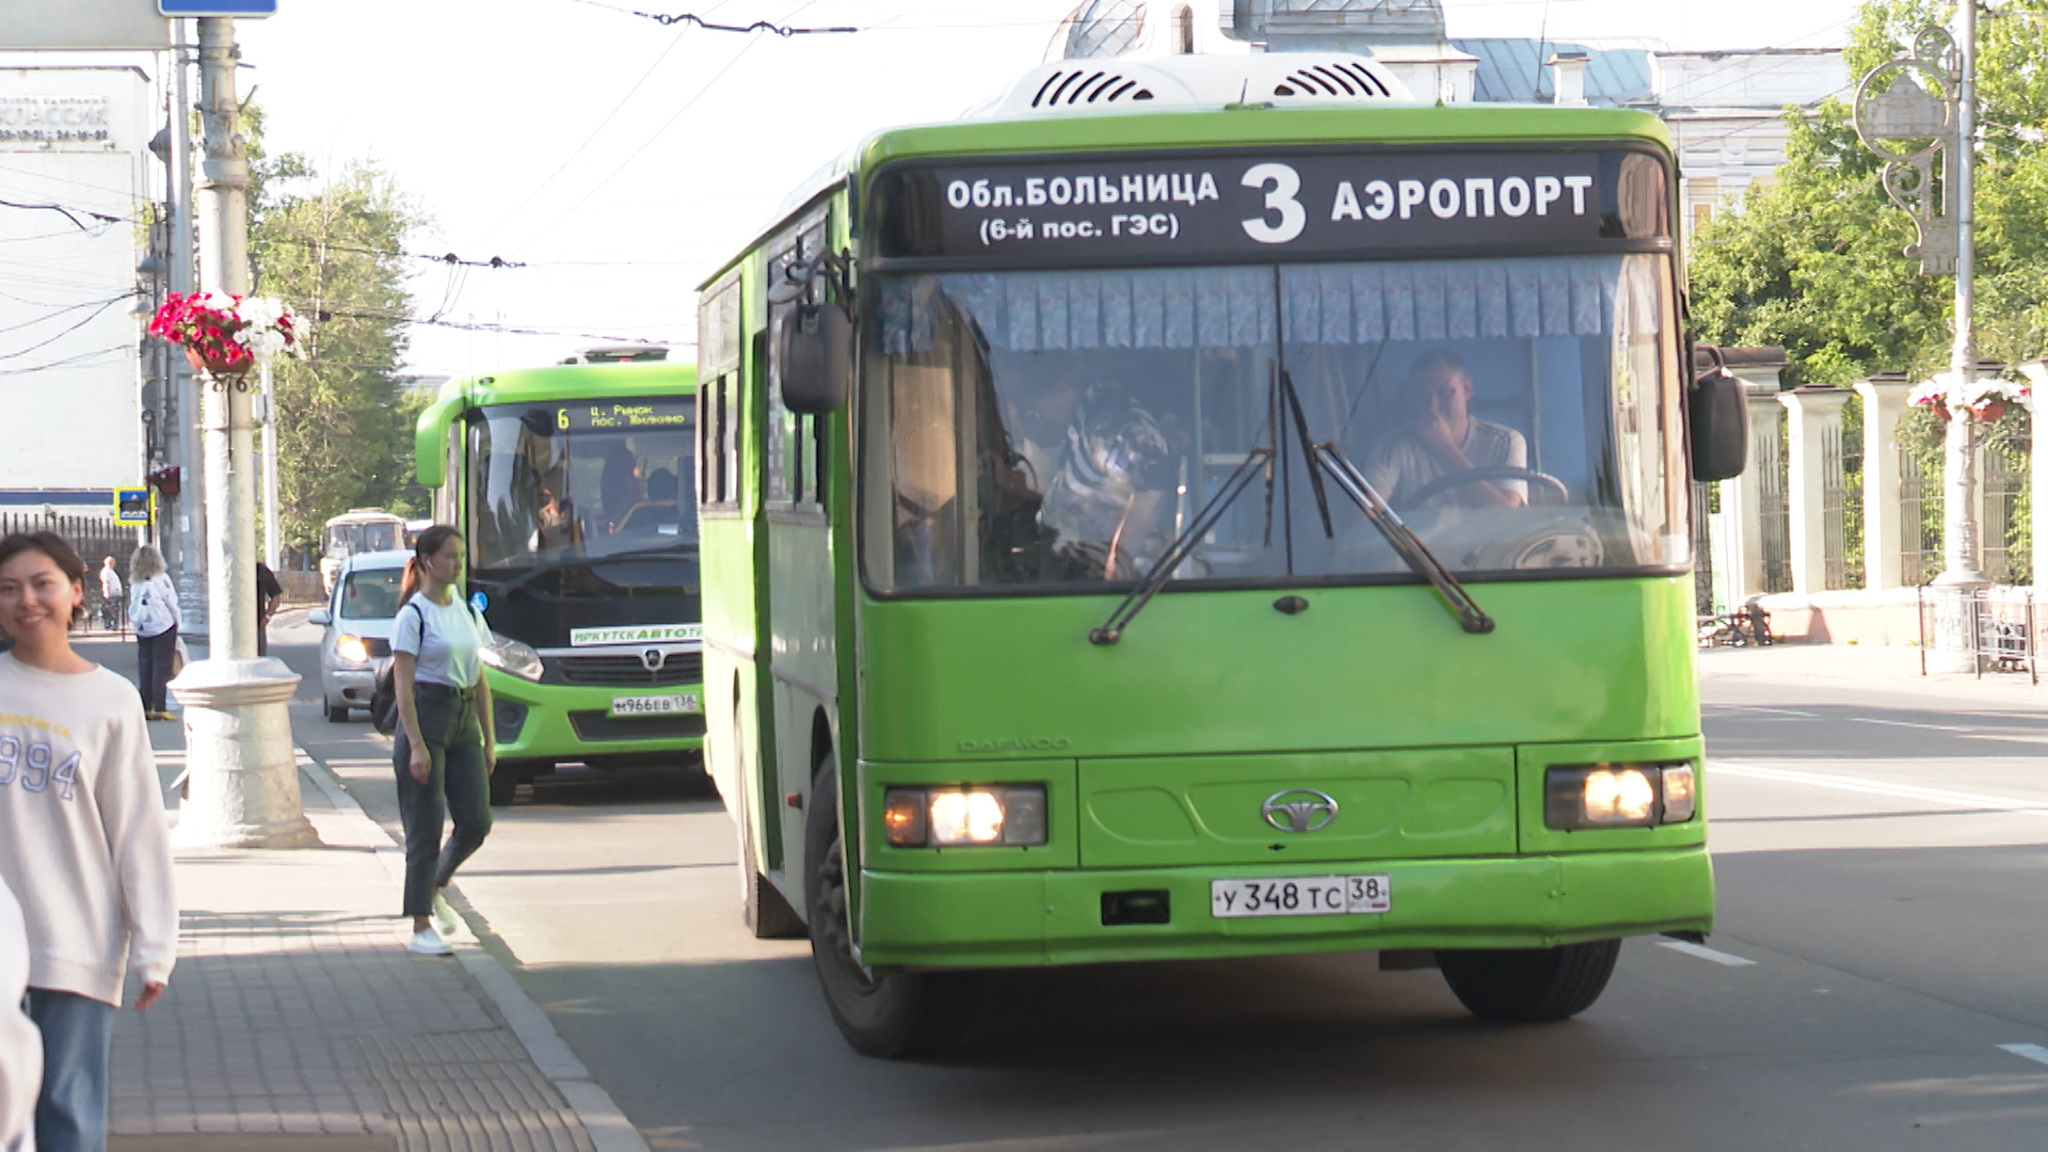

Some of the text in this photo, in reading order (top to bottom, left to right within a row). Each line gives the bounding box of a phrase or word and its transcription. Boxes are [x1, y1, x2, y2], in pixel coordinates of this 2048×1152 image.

[947, 172, 1220, 209] Обл.БОЛЬНИЦА
[1240, 162, 1307, 244] 3
[1331, 175, 1593, 221] АЭРОПОРТ
[979, 213, 1179, 245] (6-й пос. ГЭС)
[557, 408, 570, 429] 6
[957, 737, 1074, 754] DAEWOO
[1351, 878, 1379, 900] 38
